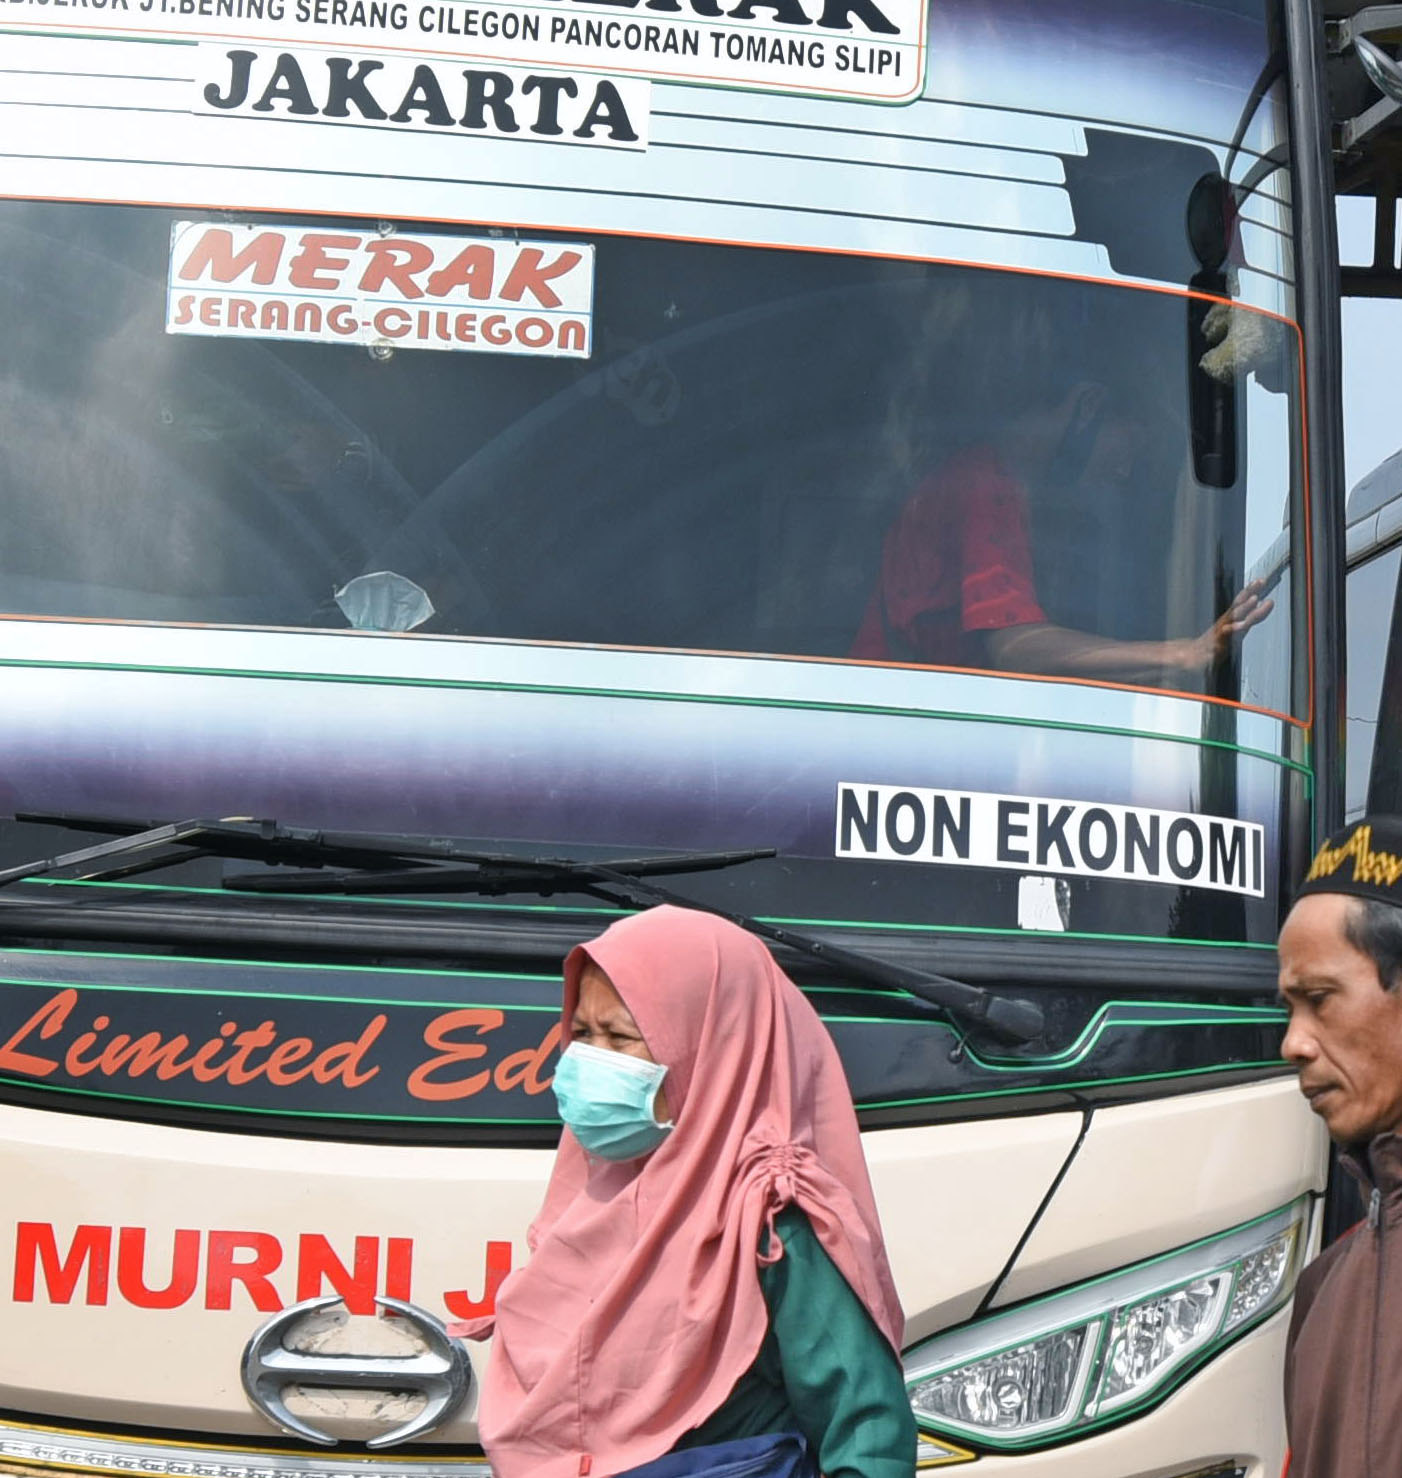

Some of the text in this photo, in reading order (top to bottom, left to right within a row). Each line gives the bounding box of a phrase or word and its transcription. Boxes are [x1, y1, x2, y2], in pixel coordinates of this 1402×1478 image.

[297, 0, 408, 30] SERANG
[418, 6, 540, 41] CILEGON
[550, 16, 699, 56] PANCORAN
[709, 32, 825, 68] TOMANG
[835, 44, 901, 76] SLIPI
[203, 49, 639, 142] JAKARTA
[178, 229, 582, 309] MERAK
[840, 788, 1263, 891] NON EKONOMI
[0, 989, 561, 1101] Limited Ed
[12, 1221, 512, 1320] MURNI J
